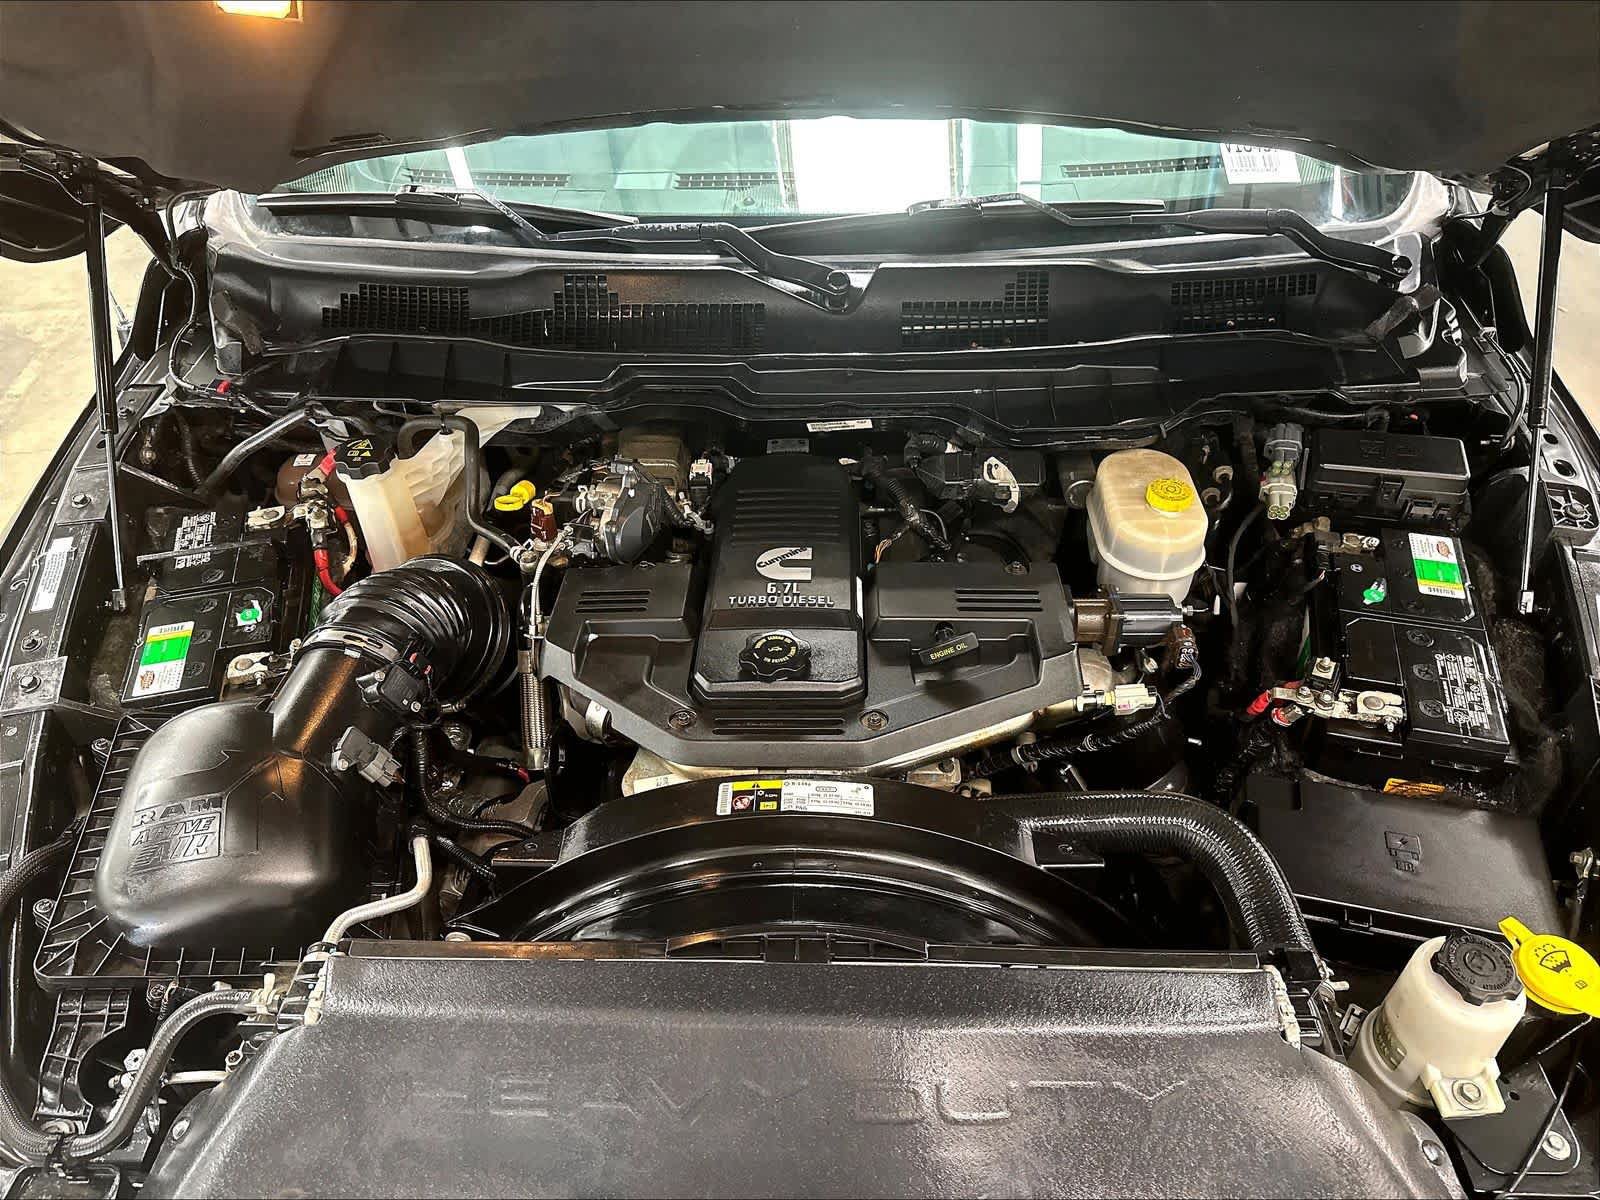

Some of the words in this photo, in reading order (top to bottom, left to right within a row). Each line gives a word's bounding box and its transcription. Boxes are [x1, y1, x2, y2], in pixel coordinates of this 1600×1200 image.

[757, 547, 808, 569] Cummins
[767, 582, 800, 594] 6.7L
[729, 595, 777, 606] TURBO
[783, 595, 834, 606] DIESEL
[930, 646, 955, 660] ENGINE
[956, 643, 968, 651] OIL
[133, 797, 223, 828] RAM
[131, 816, 216, 846] ACTIVE
[412, 1071, 808, 1125] HEAVY
[855, 1078, 1186, 1126] DUTY
